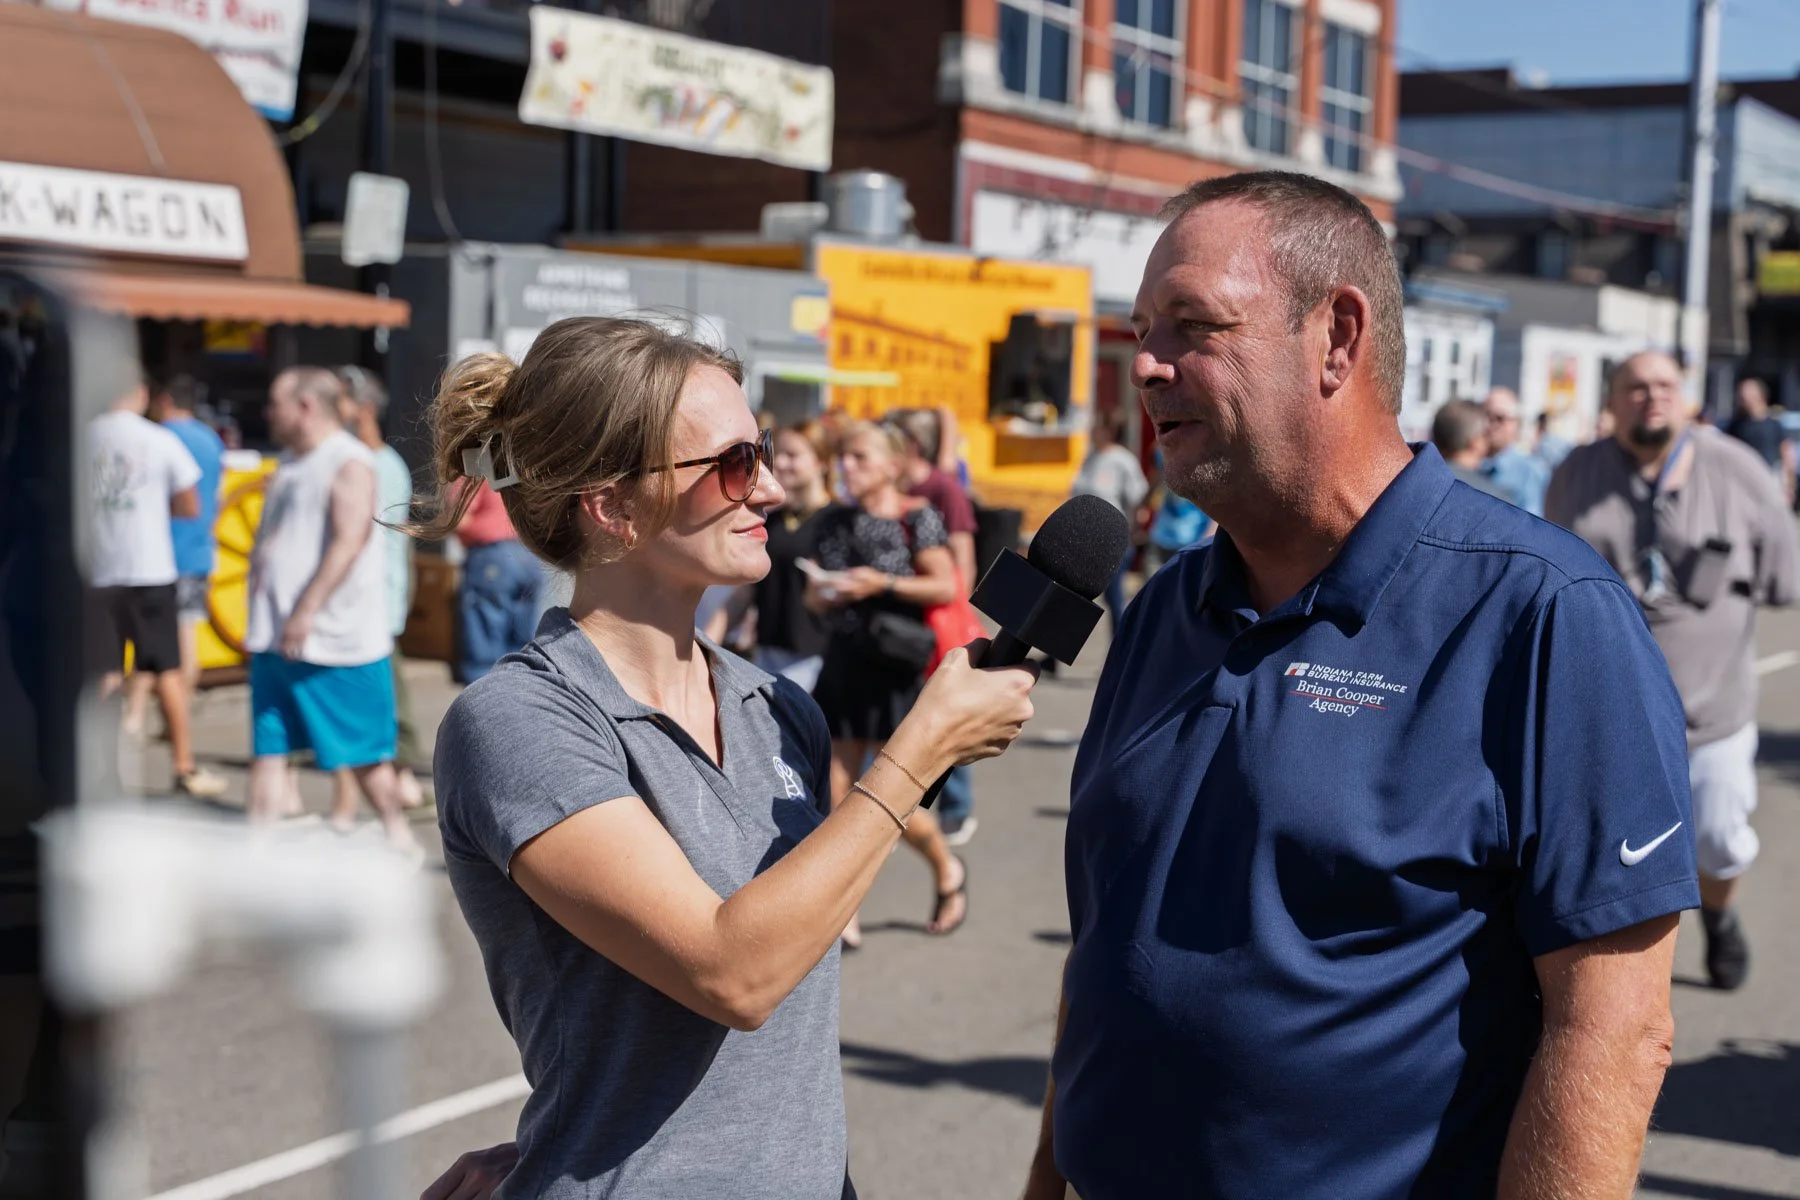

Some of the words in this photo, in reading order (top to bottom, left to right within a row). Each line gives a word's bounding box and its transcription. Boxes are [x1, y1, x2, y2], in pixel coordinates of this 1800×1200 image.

[1307, 670, 1350, 684] BUREAU
[1350, 677, 1408, 693] INSURANCE
[1311, 664, 1353, 678] INDIANA
[1355, 671, 1383, 682] FARM
[1295, 679, 1332, 697] Brian
[1336, 687, 1385, 705] Cooper
[1309, 697, 1359, 717] Agency
